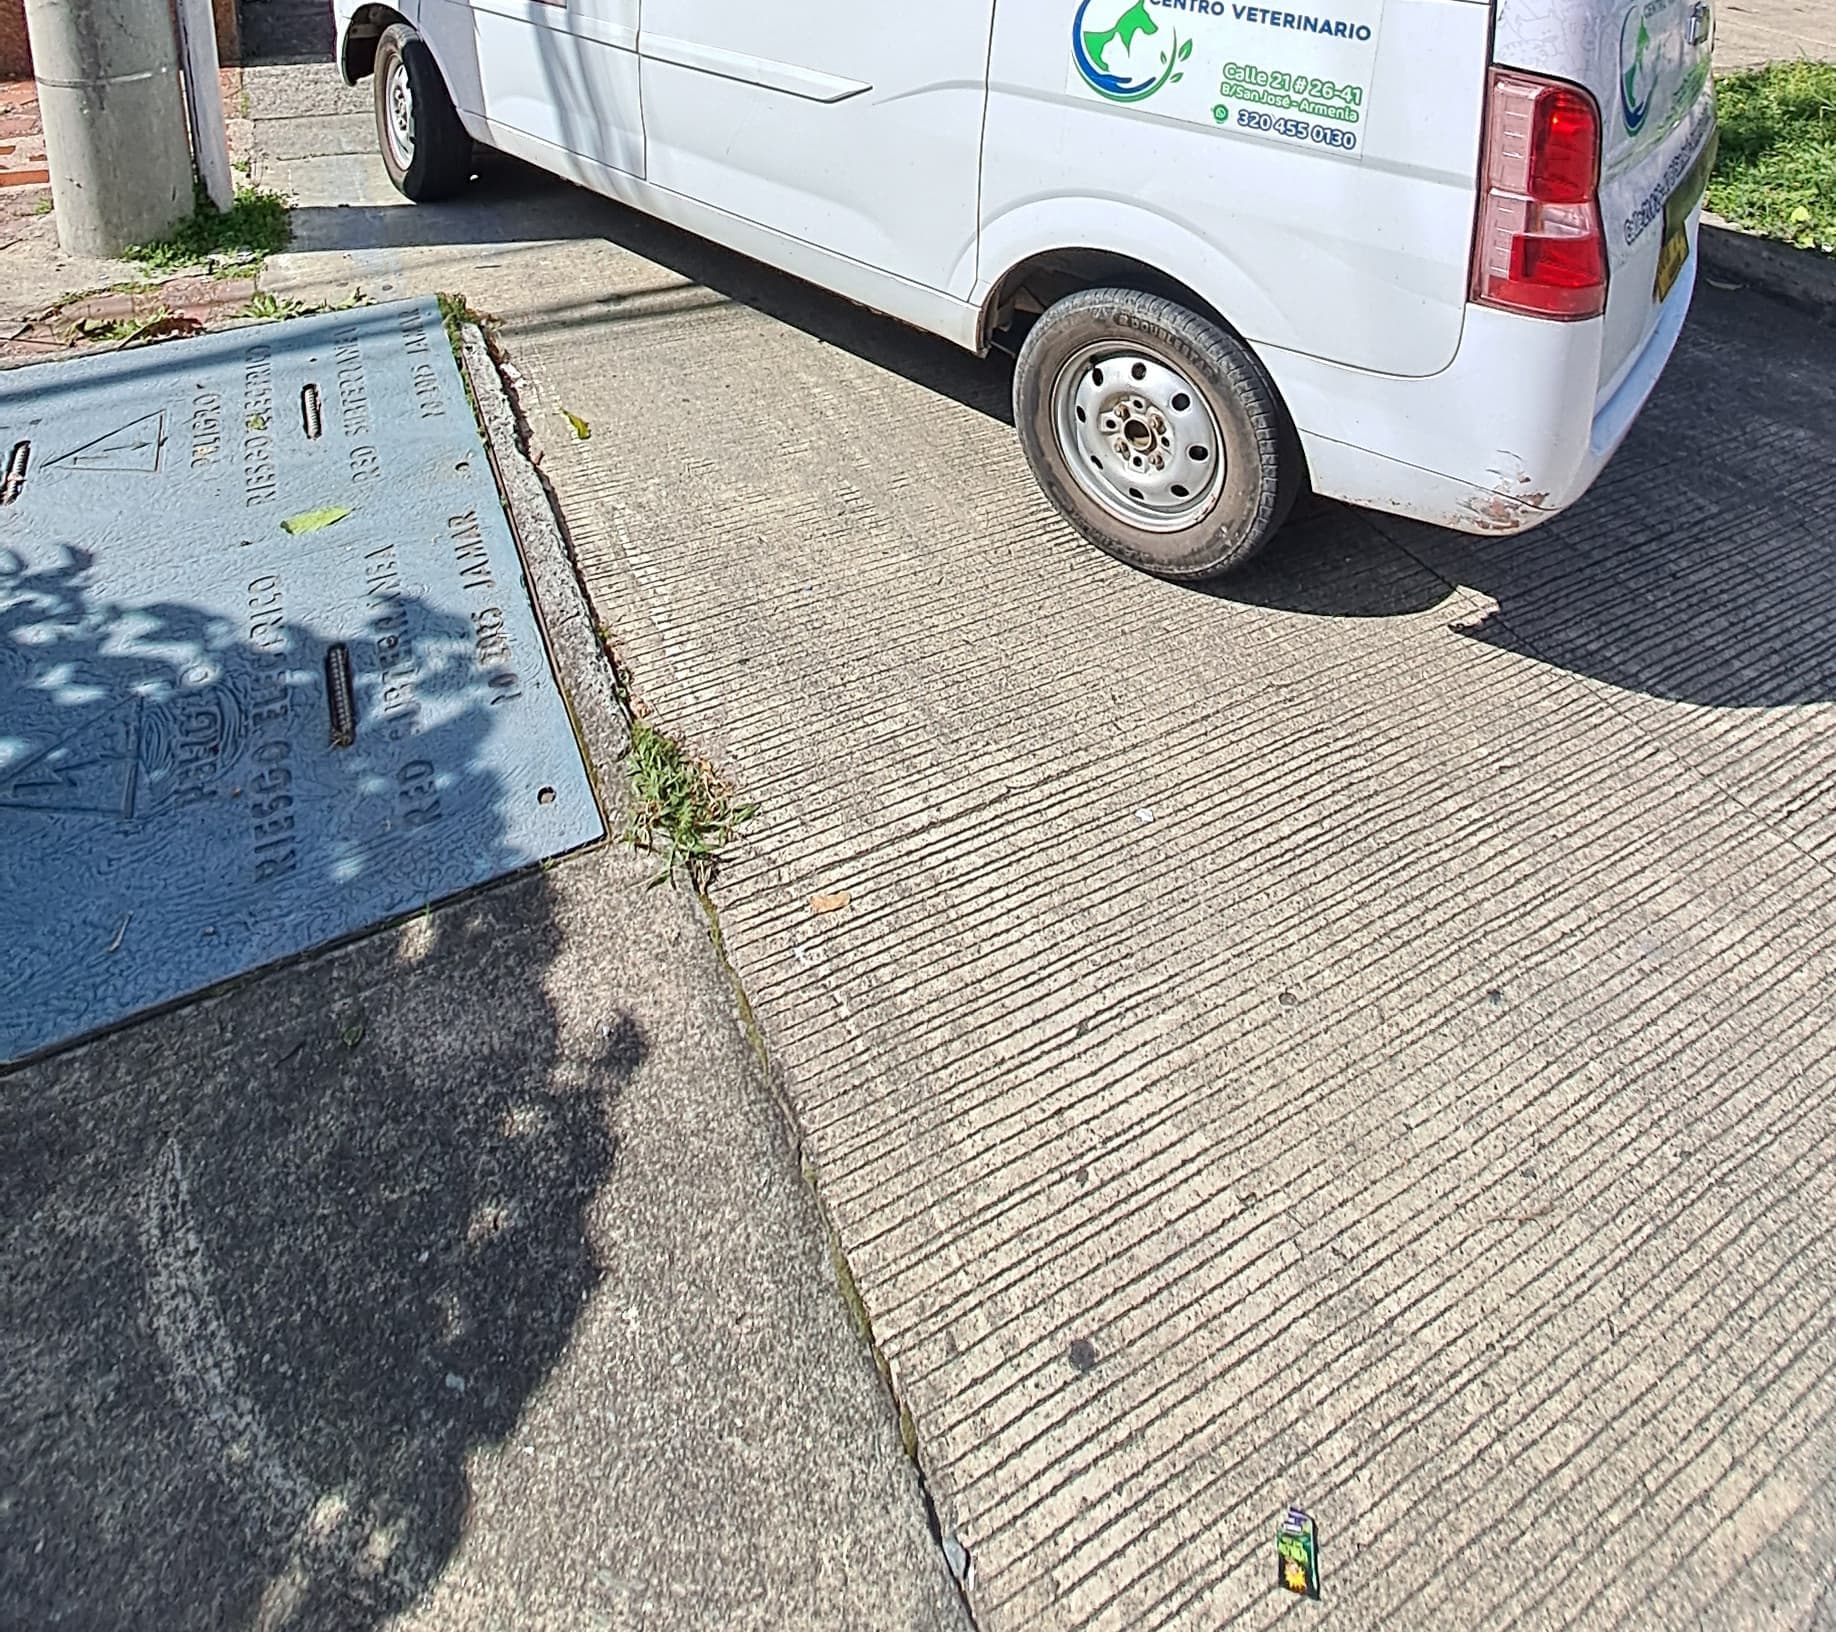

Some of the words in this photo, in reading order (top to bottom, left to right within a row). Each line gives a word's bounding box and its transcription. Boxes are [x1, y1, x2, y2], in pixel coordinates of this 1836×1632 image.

[1232, 4, 1371, 41] VETERINARIO
[1220, 82, 1260, 102] B/San
[1258, 90, 1292, 109] José
[1298, 98, 1359, 122] Armenia
[1223, 62, 1268, 86] Calle
[1269, 71, 1291, 91] 21
[1292, 75, 1308, 94] #
[1309, 78, 1363, 106] 26-41
[1237, 109, 1272, 131] 320
[1273, 118, 1310, 140] 455
[1311, 124, 1357, 150] 0130
[190, 392, 221, 469] PELIGRO
[244, 434, 277, 508] RIESGO
[350, 444, 381, 483] RED
[448, 503, 495, 590] JAMAR
[251, 739, 297, 884] RIESGO
[399, 759, 443, 828] RED
